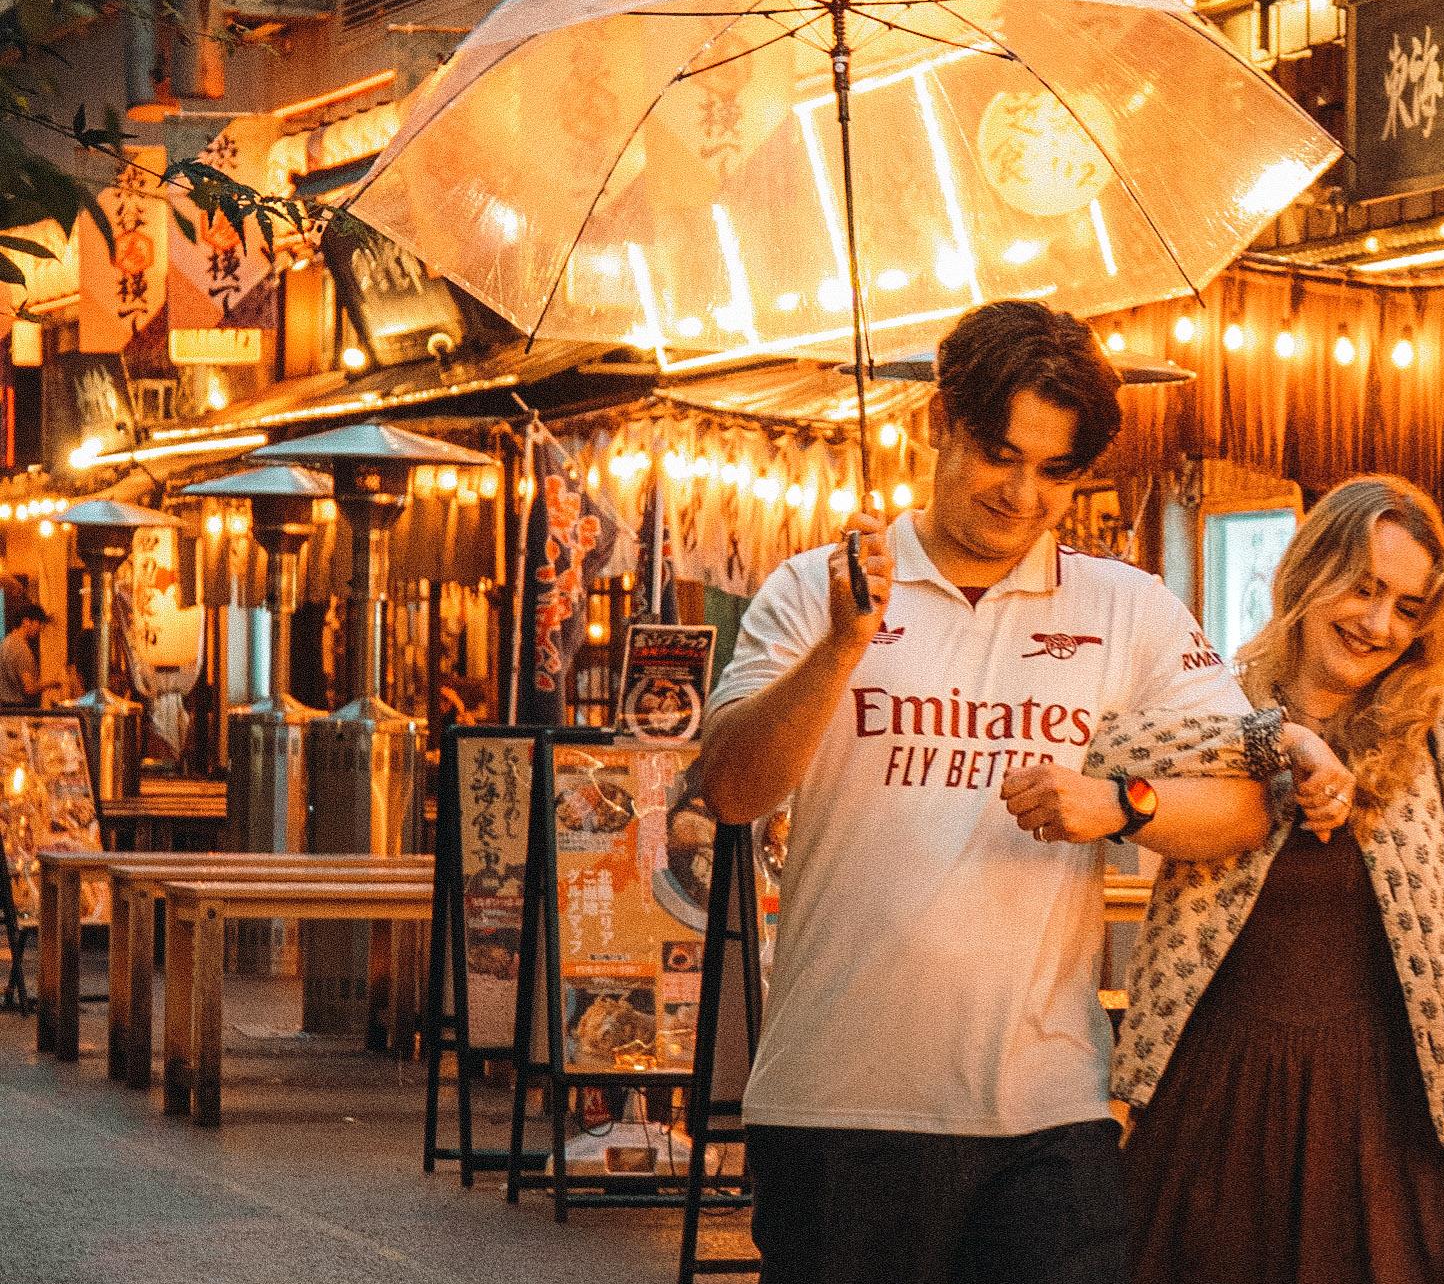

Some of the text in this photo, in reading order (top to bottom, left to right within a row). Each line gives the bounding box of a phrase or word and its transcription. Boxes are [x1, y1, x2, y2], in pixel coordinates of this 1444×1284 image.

[852, 687, 1091, 747] Emirates
[884, 745, 938, 786] FLY
[471, 746, 502, 875] 東海食市
